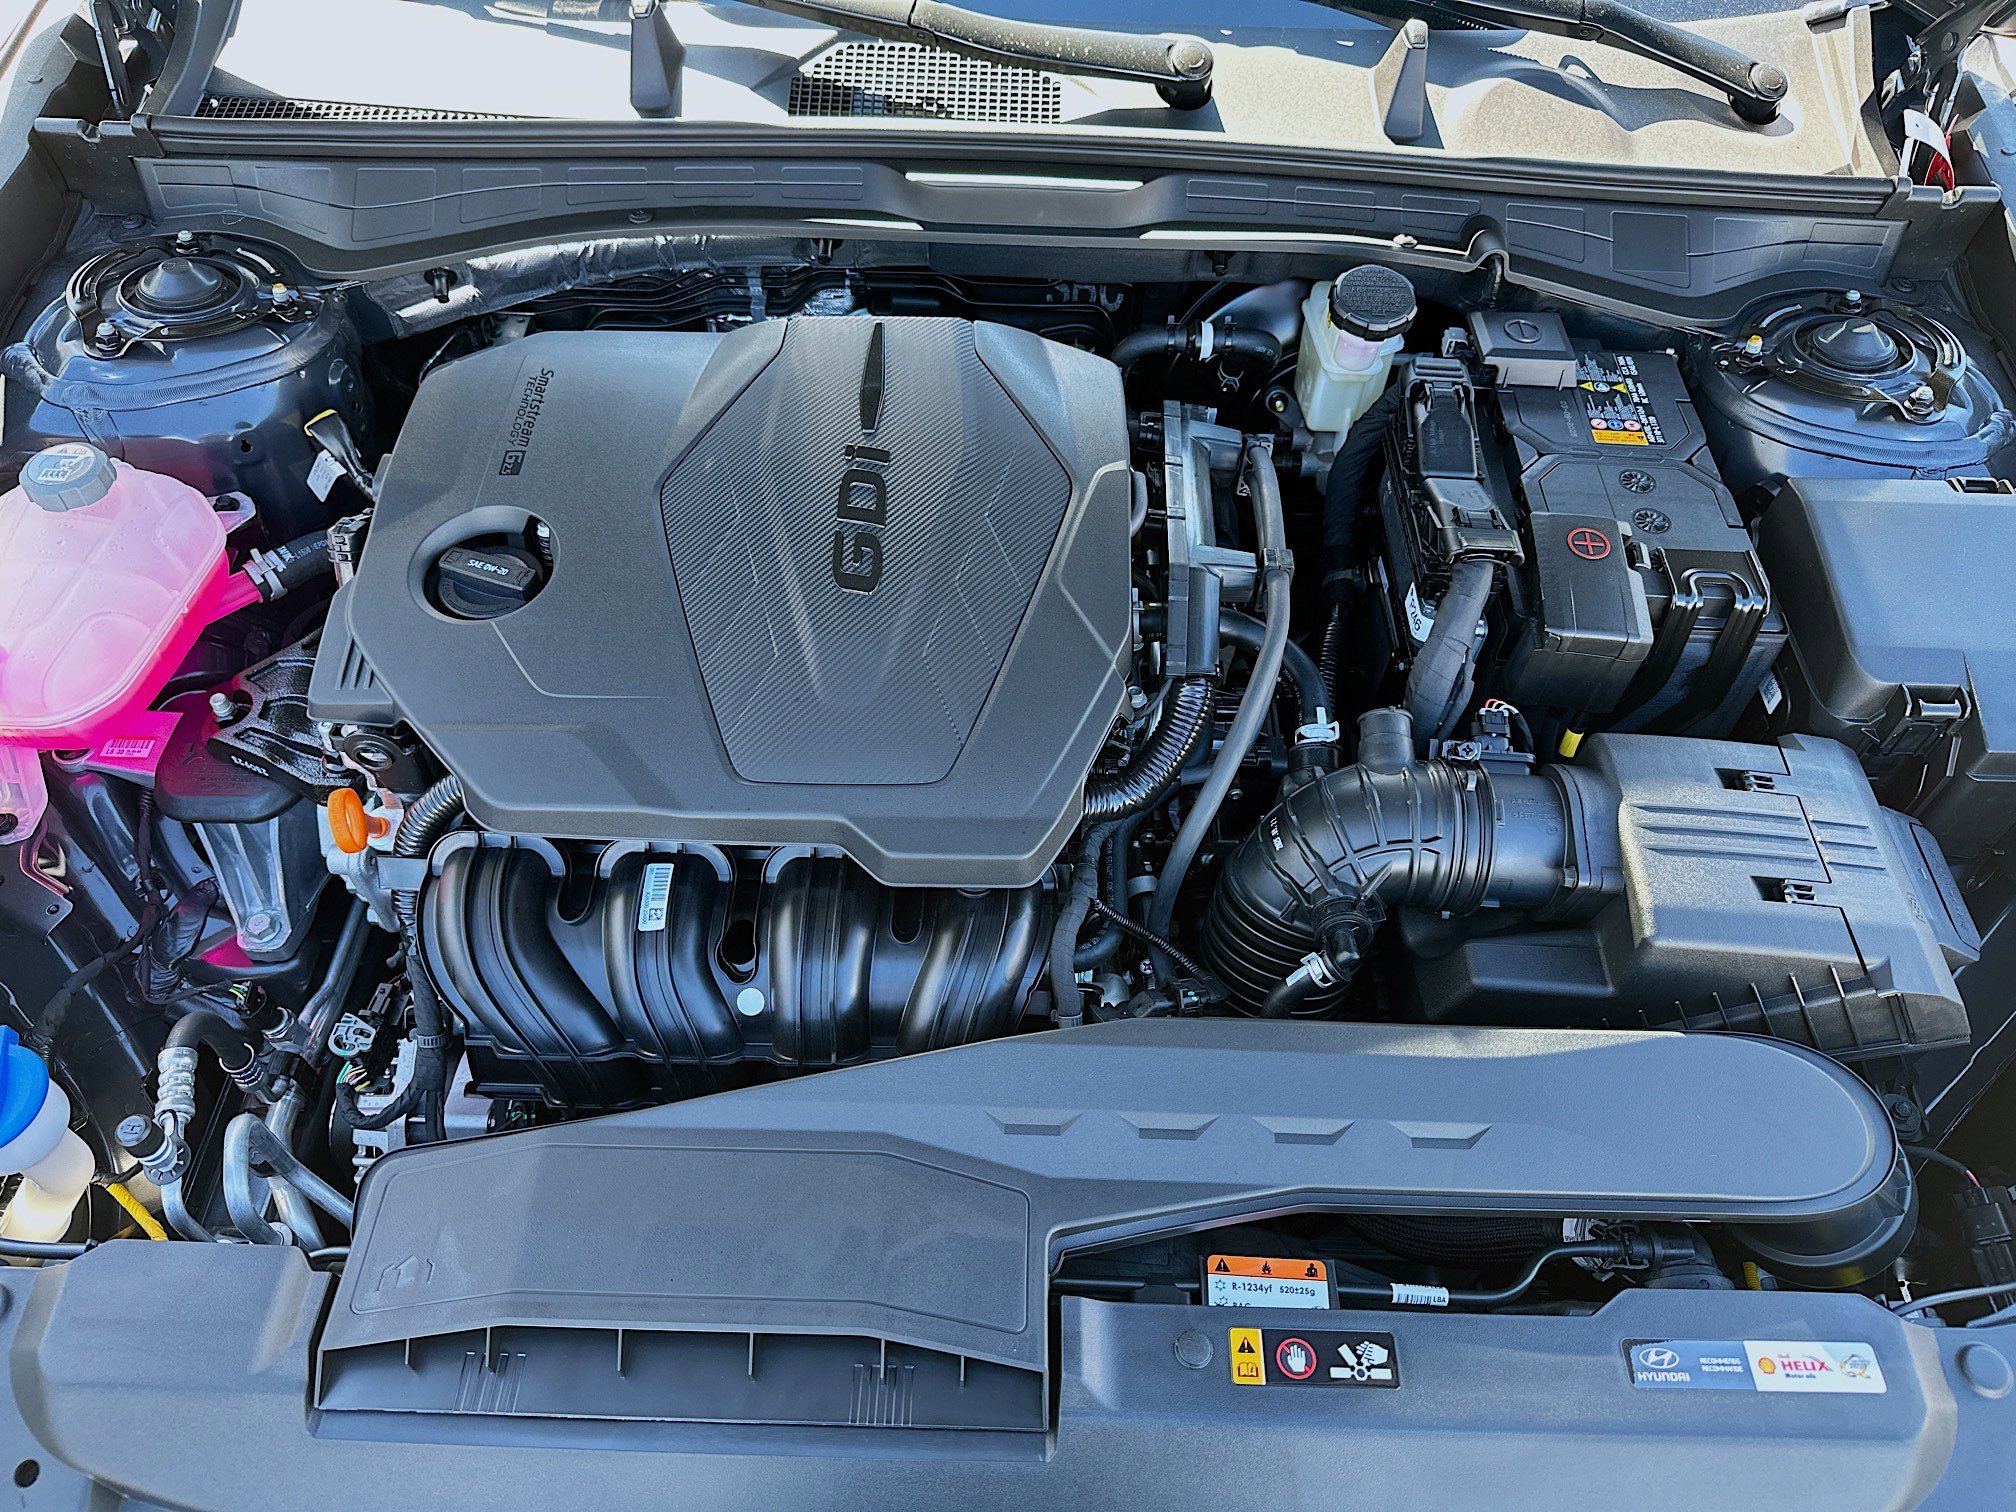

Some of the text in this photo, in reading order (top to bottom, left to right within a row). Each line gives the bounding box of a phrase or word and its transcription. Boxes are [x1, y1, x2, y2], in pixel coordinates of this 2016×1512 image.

[508, 376, 538, 447] TECHNOLOGY
[517, 368, 555, 447] Smartstream
[500, 450, 524, 476] G25
[467, 559, 509, 576] SAE 0W-20
[1231, 1282, 1316, 1297] R-1234yf 520±25g
[1781, 1360, 1832, 1372] HELIX
[1637, 1371, 1691, 1382] HYUNDAI
